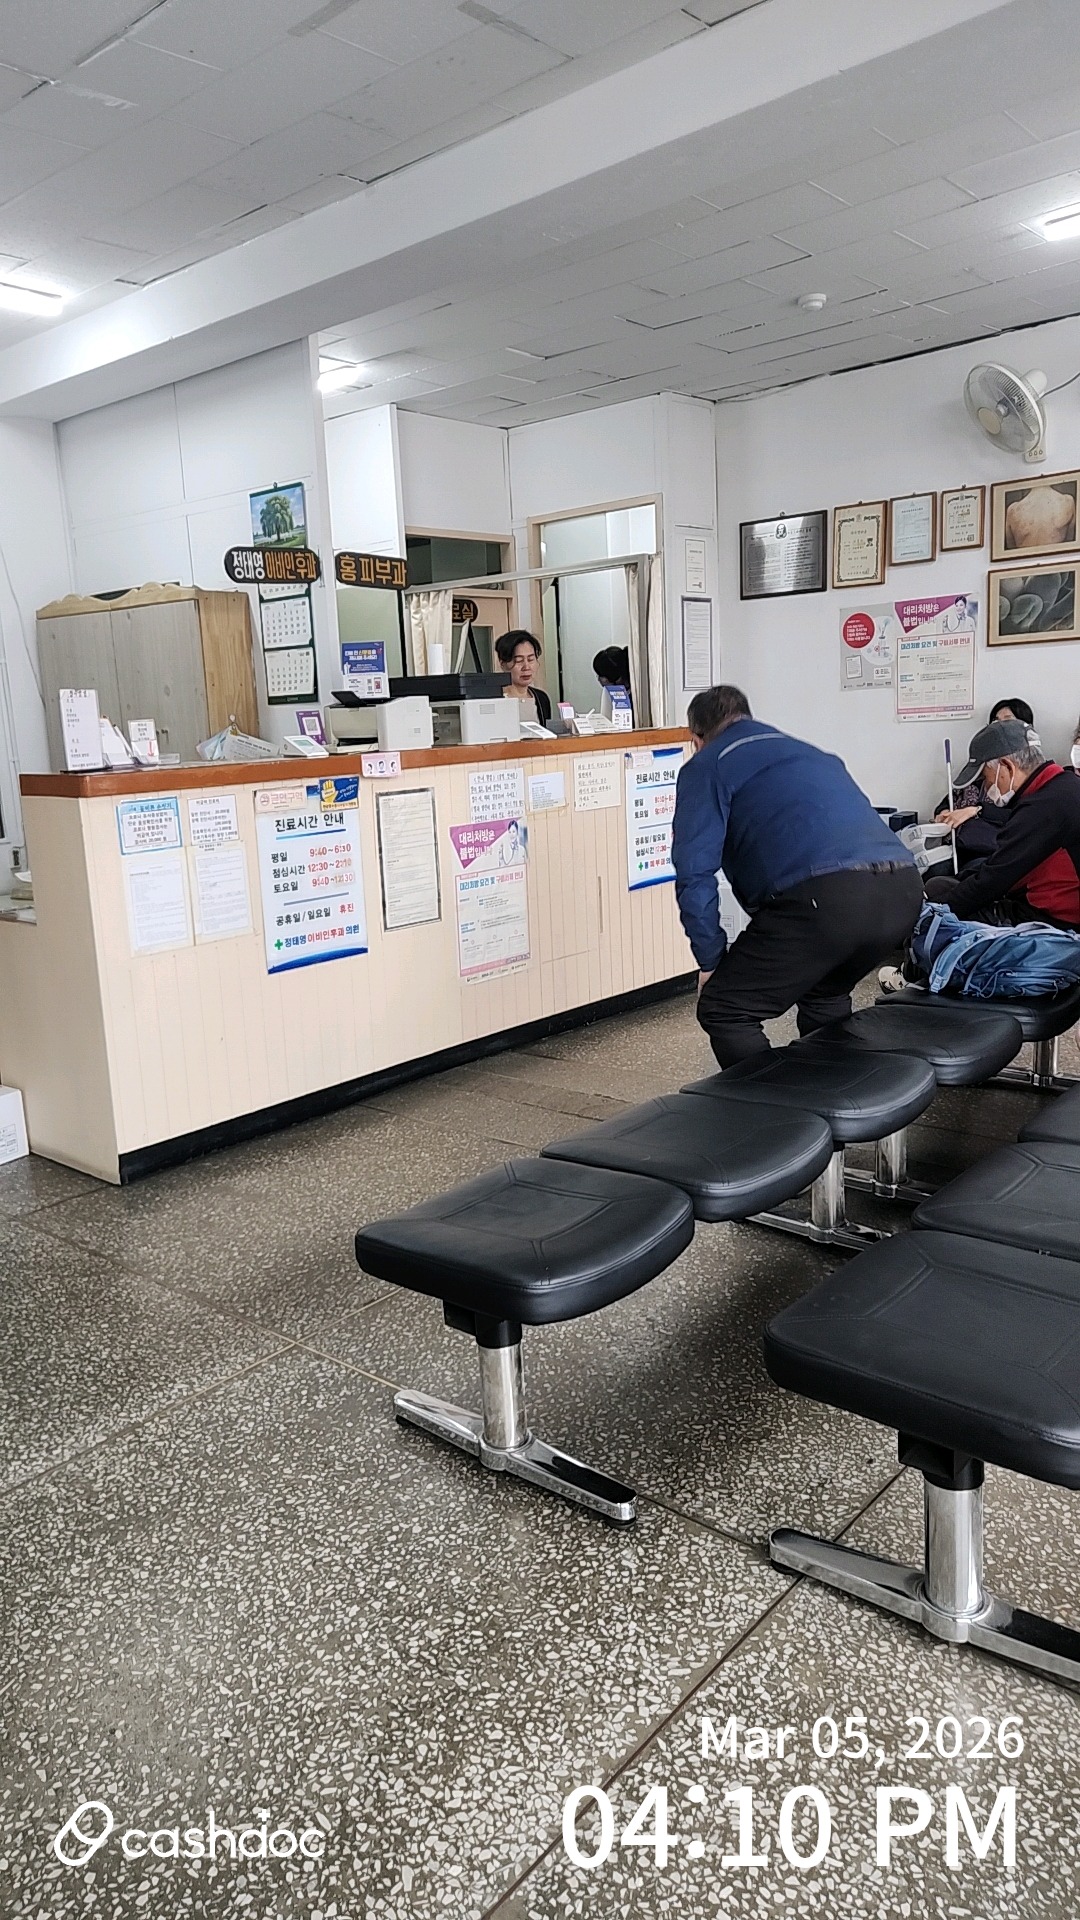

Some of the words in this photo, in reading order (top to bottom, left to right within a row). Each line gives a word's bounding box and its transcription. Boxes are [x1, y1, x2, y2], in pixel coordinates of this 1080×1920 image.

[452, 602, 474, 620] 료실
[903, 602, 940, 616] 대리처방은
[636, 772, 661, 784] 진료시간
[663, 770, 676, 781] 안내
[634, 809, 649, 820] 토요일
[274, 815, 319, 833] 진료시간
[323, 812, 345, 827] 안내
[458, 829, 495, 846] 대리처방은
[270, 850, 288, 864] 평일
[272, 864, 306, 879] 점심시간
[273, 880, 299, 894] 토요일
[339, 902, 355, 915] 휴진
